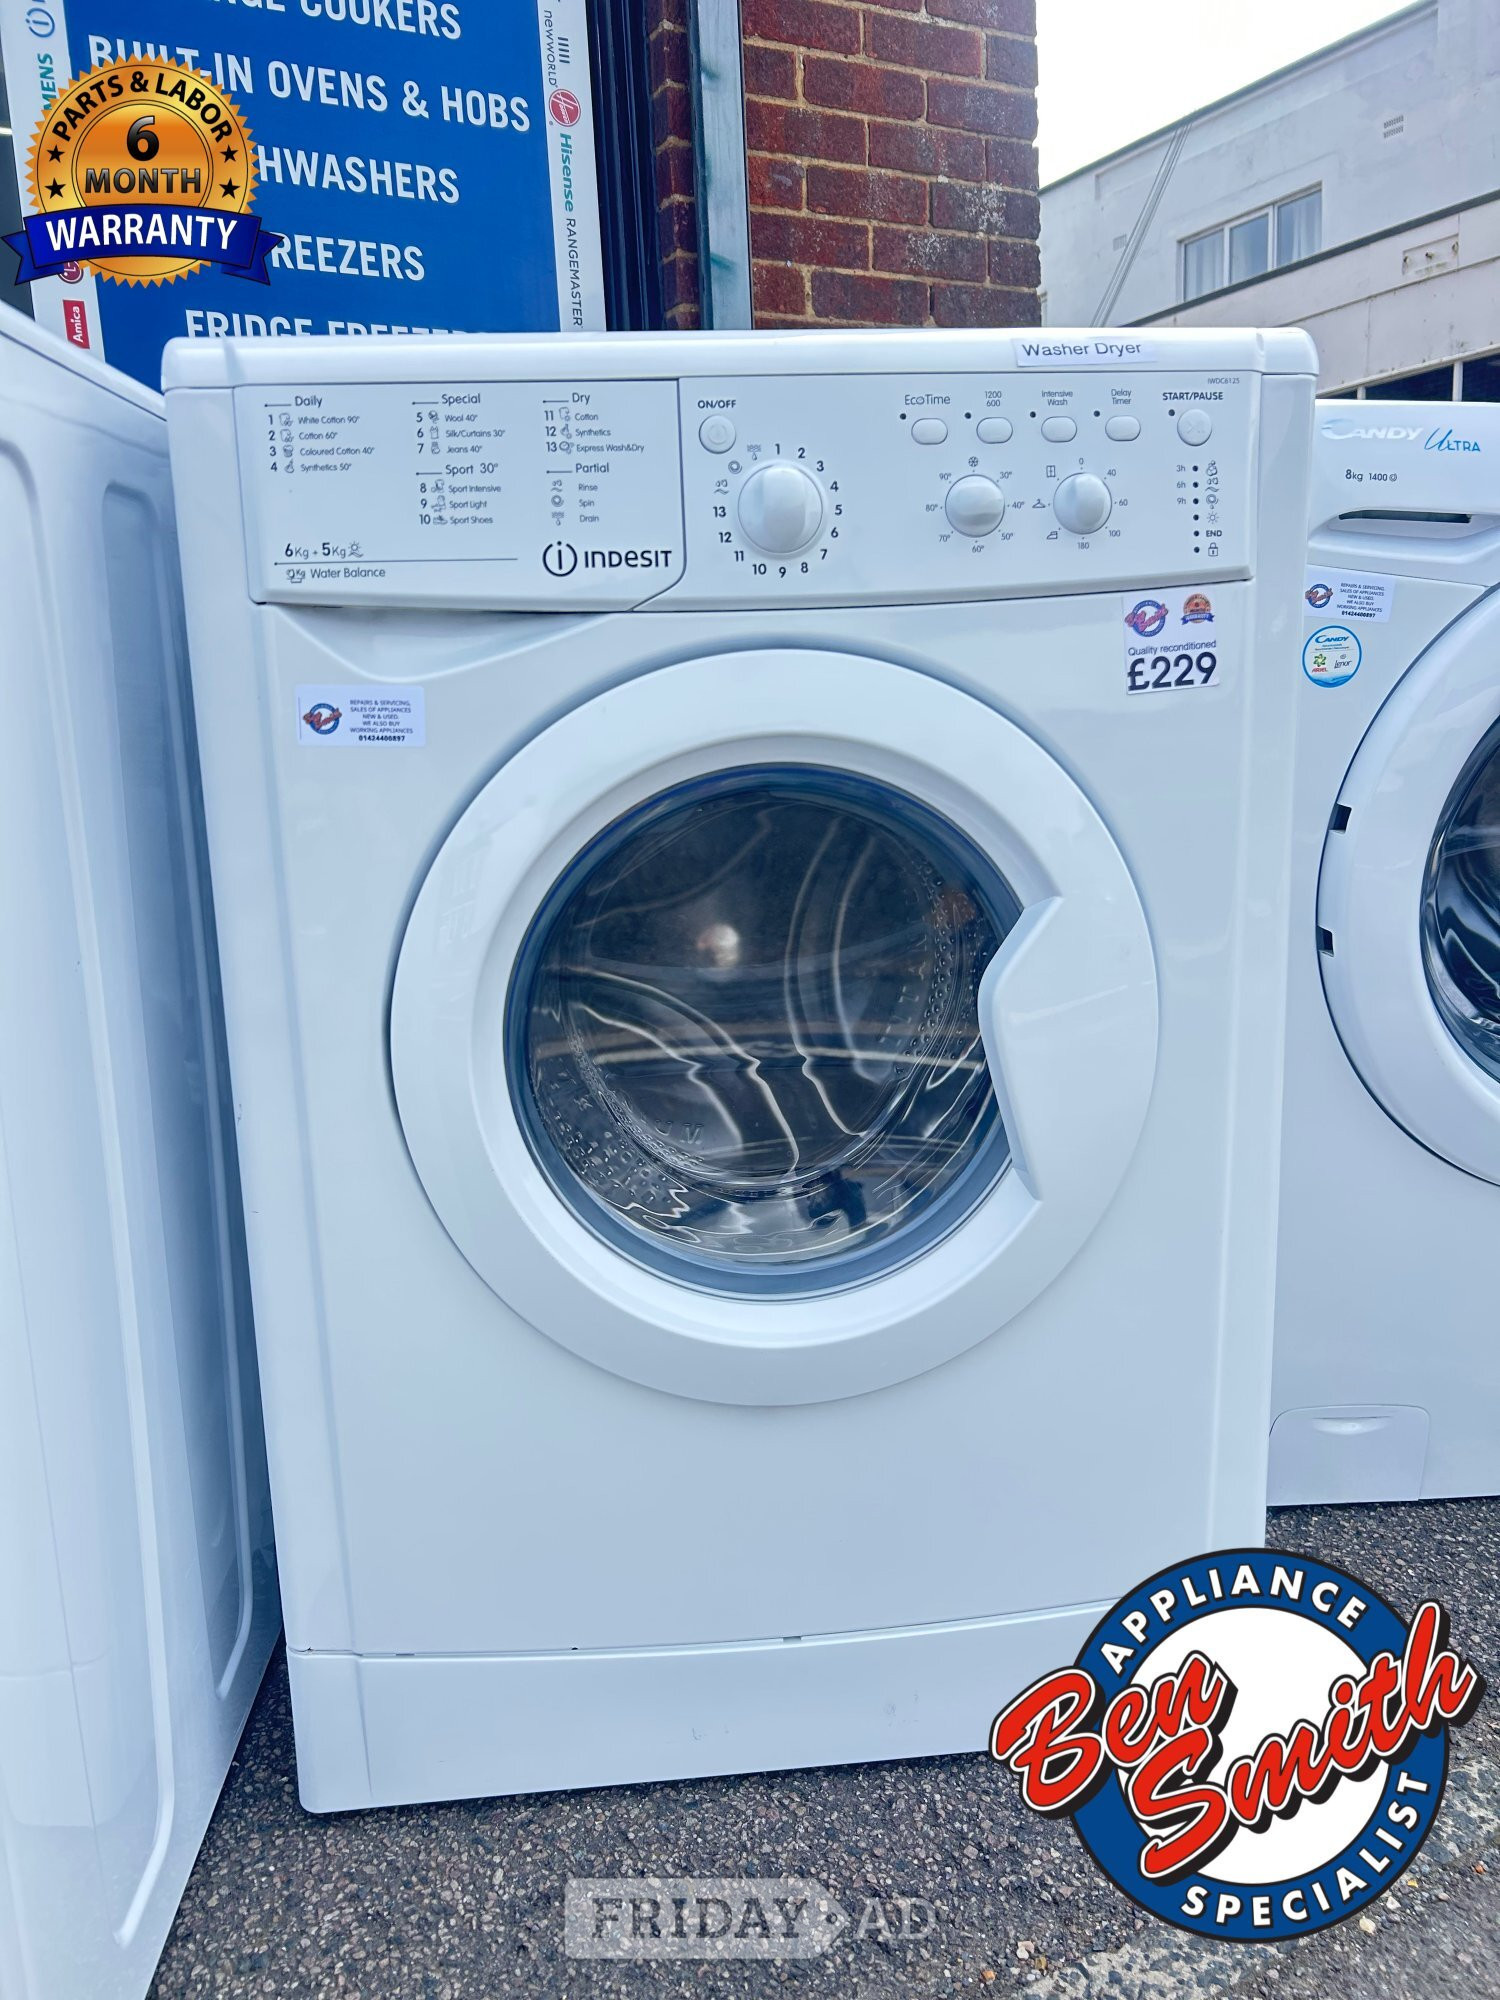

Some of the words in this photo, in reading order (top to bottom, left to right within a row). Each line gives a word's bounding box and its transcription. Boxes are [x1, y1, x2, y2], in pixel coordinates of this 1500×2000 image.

[268, 61, 387, 112] OVENS
[403, 81, 428, 117] &
[442, 86, 531, 132] HOBS
[560, 133, 574, 212] Hisense
[270, 231, 425, 281] REEZERS
[566, 218, 582, 326] RANGEMASTER
[72, 306, 83, 342] Amica
[1022, 344, 1089, 357] Washer
[1095, 343, 1141, 358] Dryer
[572, 392, 590, 405] Dry
[985, 391, 1002, 399] 1200
[1041, 390, 1073, 398] Intensive
[1110, 389, 1132, 398] Delay
[1162, 392, 1223, 401] START/PAUSE
[295, 395, 322, 408] Daily
[441, 393, 481, 406] Special
[697, 399, 737, 409] ON/OFF
[904, 394, 951, 406] EcoTime
[986, 399, 1000, 407] 600
[1047, 397, 1068, 406] Wash
[1112, 397, 1131, 405] Timer
[268, 414, 273, 425] 1
[298, 416, 320, 424] White
[321, 416, 346, 424] Cotton
[416, 412, 423, 422] 5
[445, 414, 463, 422] Wool
[544, 410, 554, 421] 11
[575, 413, 598, 421] Cotton
[268, 430, 275, 440] 2
[299, 432, 324, 440] Cotton
[417, 427, 424, 438] 6
[445, 429, 492, 438] Silk/Curtains
[545, 426, 557, 436] 12
[575, 428, 611, 437] Synthetics
[1321, 419, 1424, 441] CANDY
[269, 446, 277, 456] 3
[300, 448, 334, 456] Coloured
[336, 447, 361, 455] Cotton
[417, 443, 424, 454] 7
[447, 446, 468, 454] Jeans
[546, 441, 557, 452] 13
[577, 444, 604, 453] Express
[606, 444, 645, 453] Wash&Dry
[775, 443, 781, 455] 1
[798, 447, 806, 459] 2
[816, 460, 824, 472] 3
[1078, 457, 1084, 465] 0
[270, 462, 278, 472] 4
[300, 464, 338, 472] Synthetics
[445, 464, 474, 477] Sport
[575, 463, 610, 473] Partial
[1345, 469, 1364, 482] 8kg
[1369, 472, 1388, 481] 1400
[420, 482, 427, 493] 8
[448, 485, 468, 494] Sport
[830, 481, 839, 492] 4
[420, 498, 427, 509] 9
[449, 501, 469, 509] Sport
[470, 500, 487, 509] Light
[579, 499, 595, 508] Spin
[1119, 499, 1128, 507] 60
[1177, 497, 1186, 505] 9h
[713, 506, 727, 518] 13
[834, 504, 842, 516] 5
[419, 514, 431, 525] 10
[450, 516, 469, 525] Sport
[470, 516, 493, 524] Shoes
[718, 532, 732, 543] 12
[831, 527, 838, 538] 6
[285, 543, 309, 560] 6Kg
[322, 542, 346, 559] 5Kg
[1077, 542, 1090, 550] 180
[734, 551, 745, 562] 11
[820, 549, 828, 560] 7
[310, 569, 341, 578] Water
[343, 568, 386, 578] Balance
[752, 563, 767, 575] 10
[779, 567, 786, 578] 9
[801, 562, 808, 573] 8
[1127, 646, 1158, 656] Quality
[1160, 639, 1216, 653] reconditioned
[1127, 651, 1217, 691] £229
